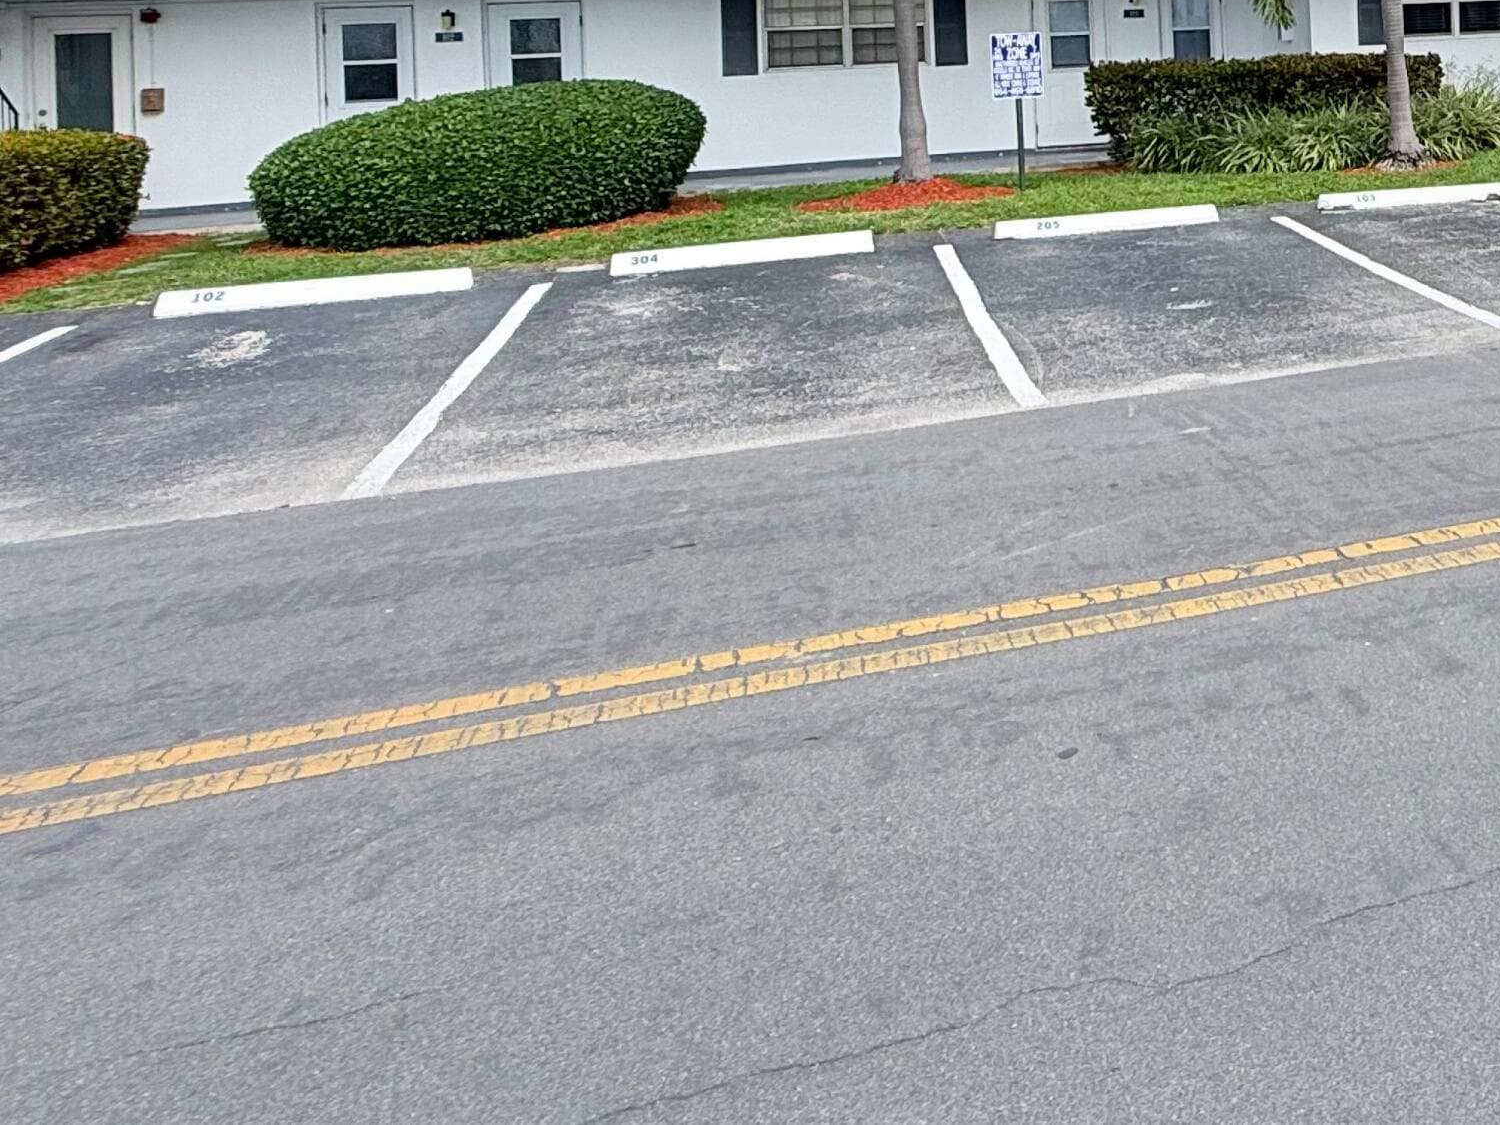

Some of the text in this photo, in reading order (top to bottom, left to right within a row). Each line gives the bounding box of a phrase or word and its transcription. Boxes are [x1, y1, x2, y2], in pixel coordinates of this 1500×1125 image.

[1006, 46, 1028, 60] ZONE
[631, 254, 658, 265] 304
[191, 290, 226, 304] 102
